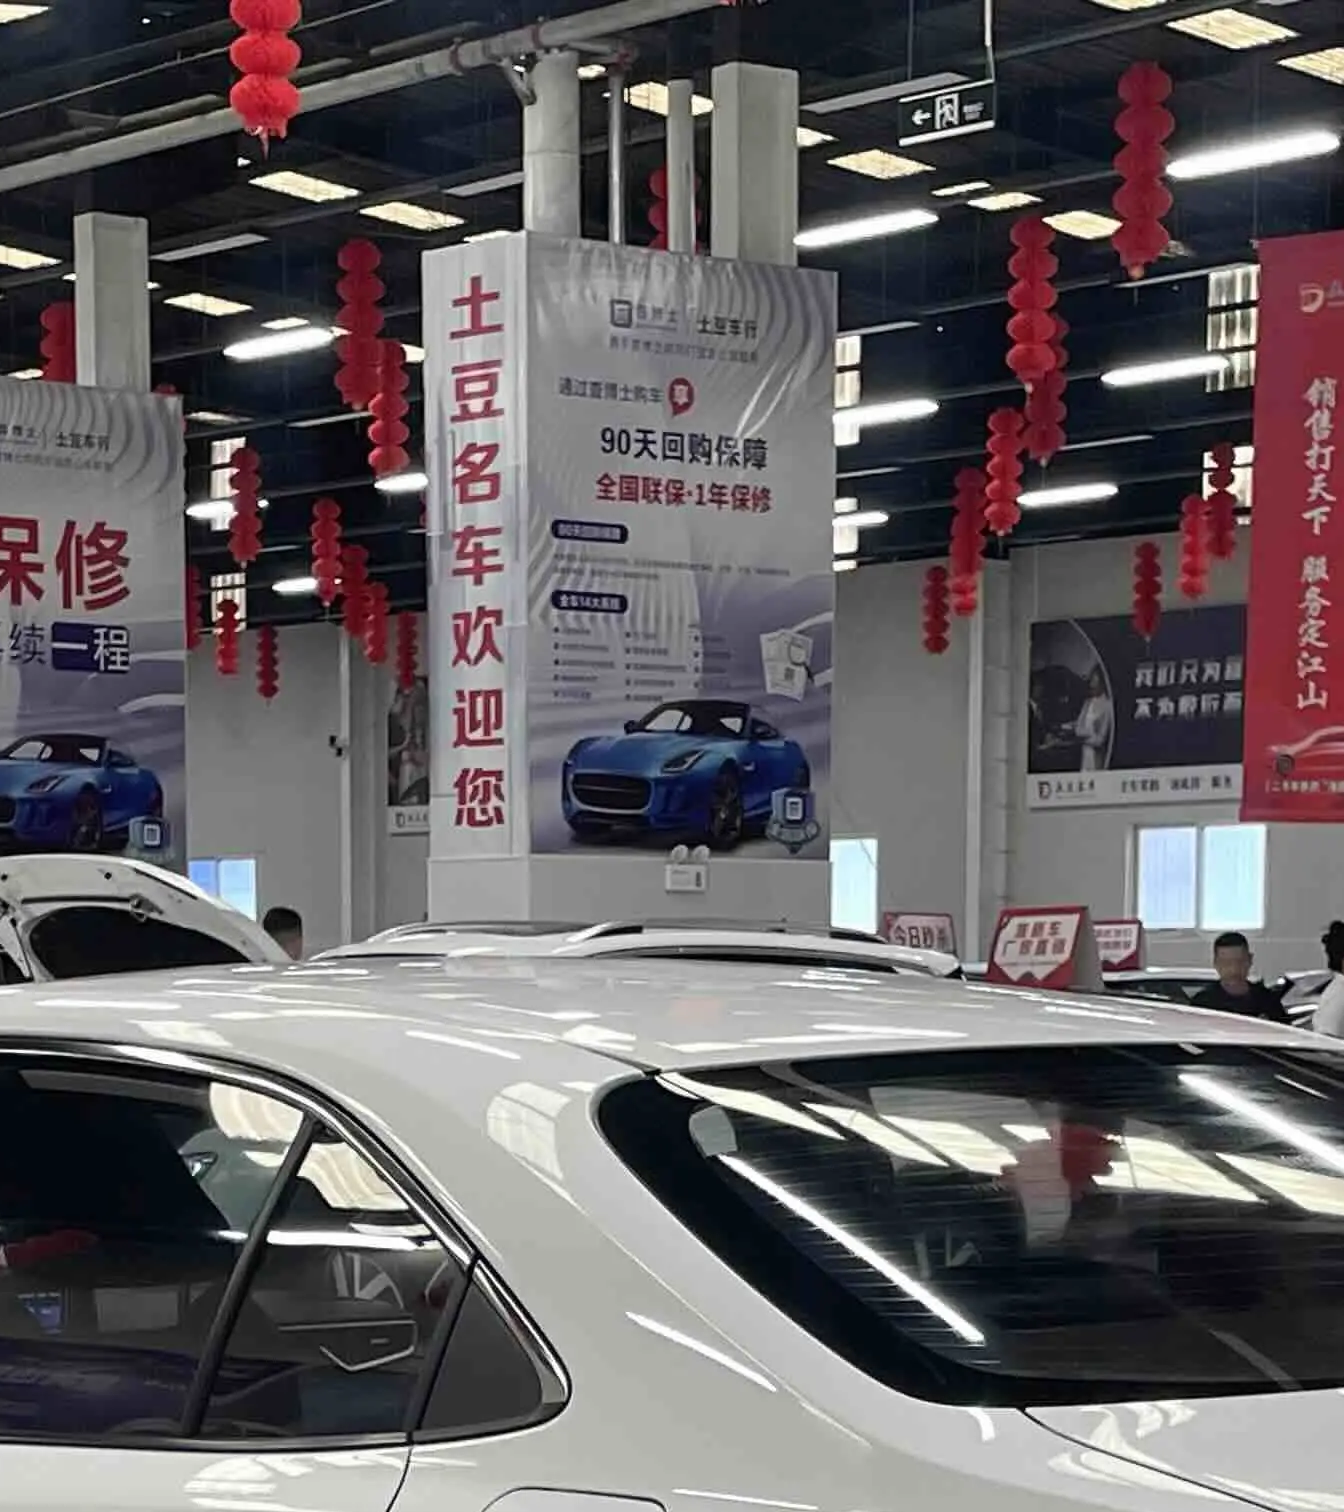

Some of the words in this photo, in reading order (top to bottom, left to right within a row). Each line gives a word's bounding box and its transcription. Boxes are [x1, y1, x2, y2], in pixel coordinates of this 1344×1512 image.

[600, 427, 769, 471] 90天回购保障
[1302, 377, 1338, 536] 销售打天下
[449, 276, 505, 828] 土豆名车欢迎您
[1297, 556, 1330, 712] 服务定江山
